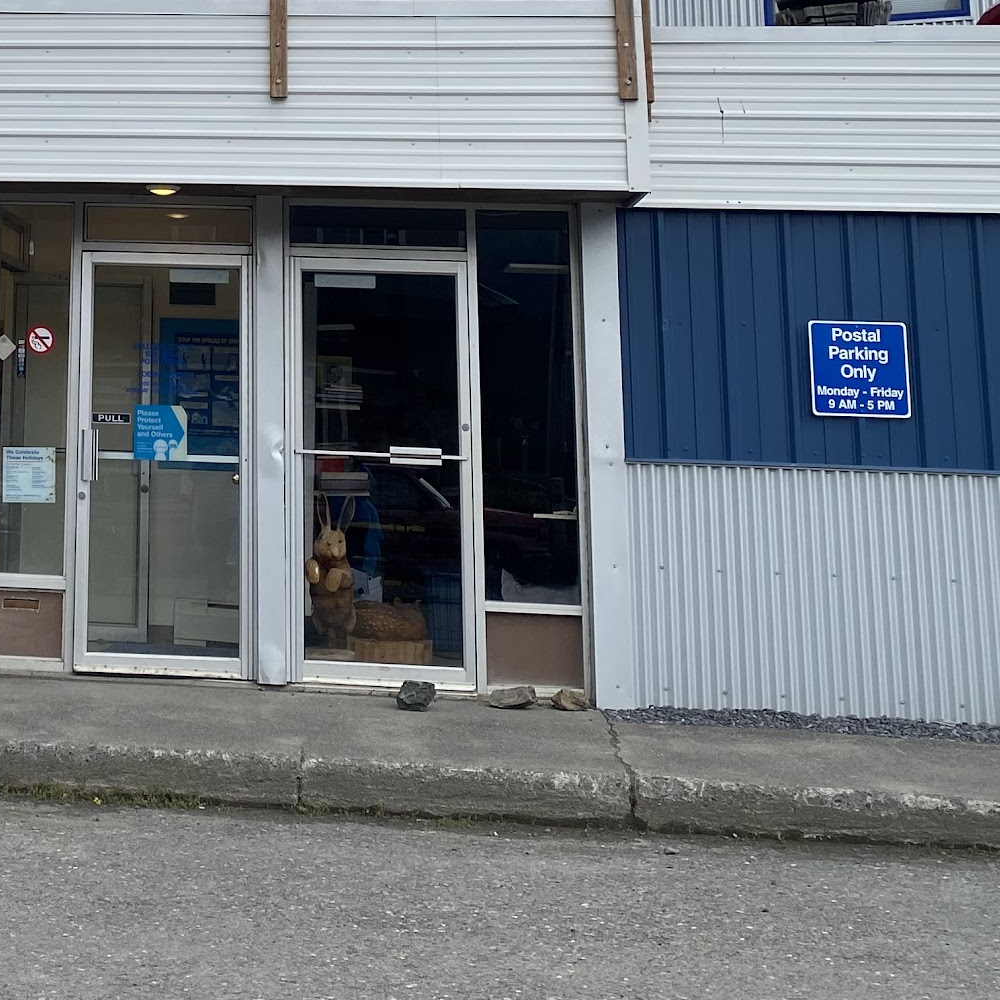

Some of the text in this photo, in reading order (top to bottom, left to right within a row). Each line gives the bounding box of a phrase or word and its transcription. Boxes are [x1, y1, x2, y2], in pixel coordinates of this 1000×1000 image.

[831, 327, 881, 343] Postal
[828, 345, 889, 364] Parking
[840, 364, 877, 383] Only
[816, 385, 860, 399] Monday
[870, 386, 904, 400] Friday
[828, 399, 836, 409] 9
[838, 399, 857, 410] AM
[867, 400, 874, 410] 5
[877, 400, 896, 411] PM
[98, 414, 125, 422] PULL
[136, 423, 164, 431] Yourself
